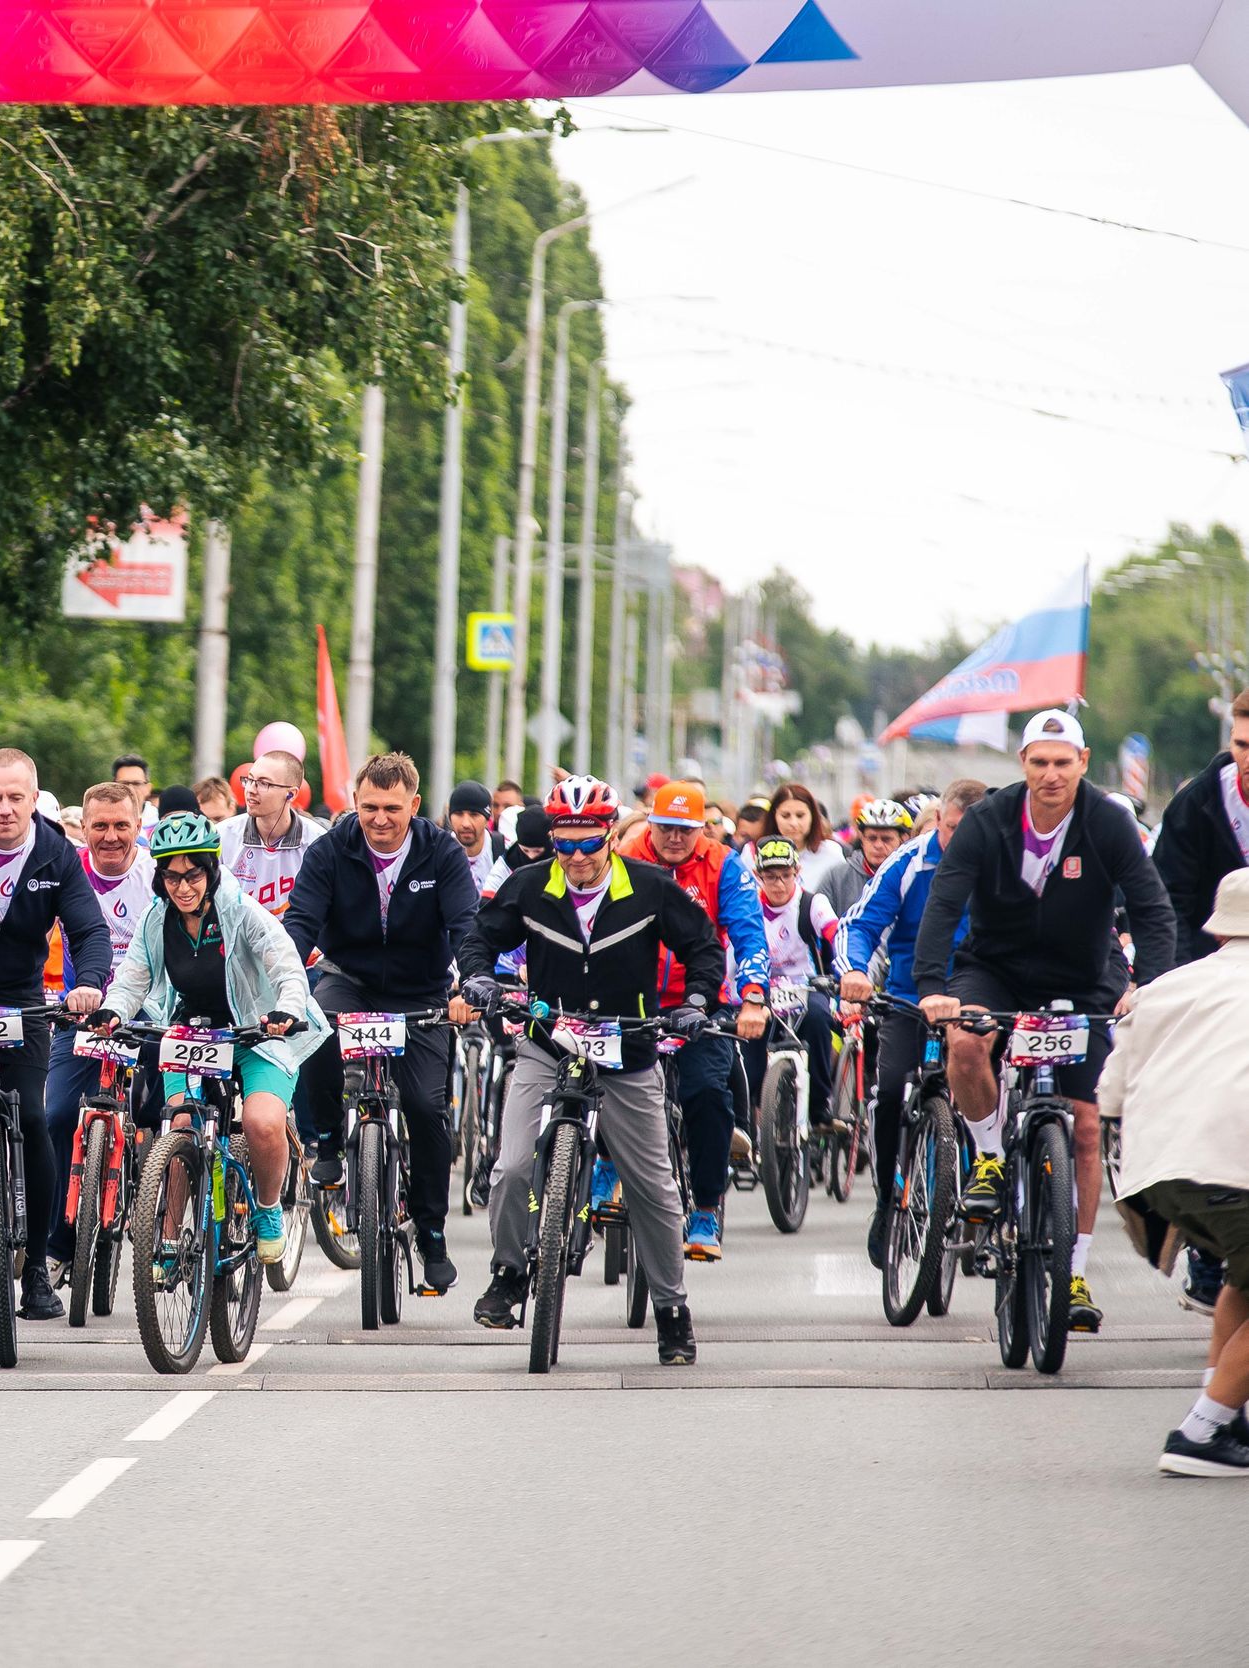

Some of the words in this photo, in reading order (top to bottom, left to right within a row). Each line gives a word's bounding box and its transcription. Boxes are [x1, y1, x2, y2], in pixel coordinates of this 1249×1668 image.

[760, 841, 790, 857] 46
[352, 1026, 391, 1042] 444
[1028, 1034, 1072, 1052] 256
[174, 1043, 218, 1064] 202
